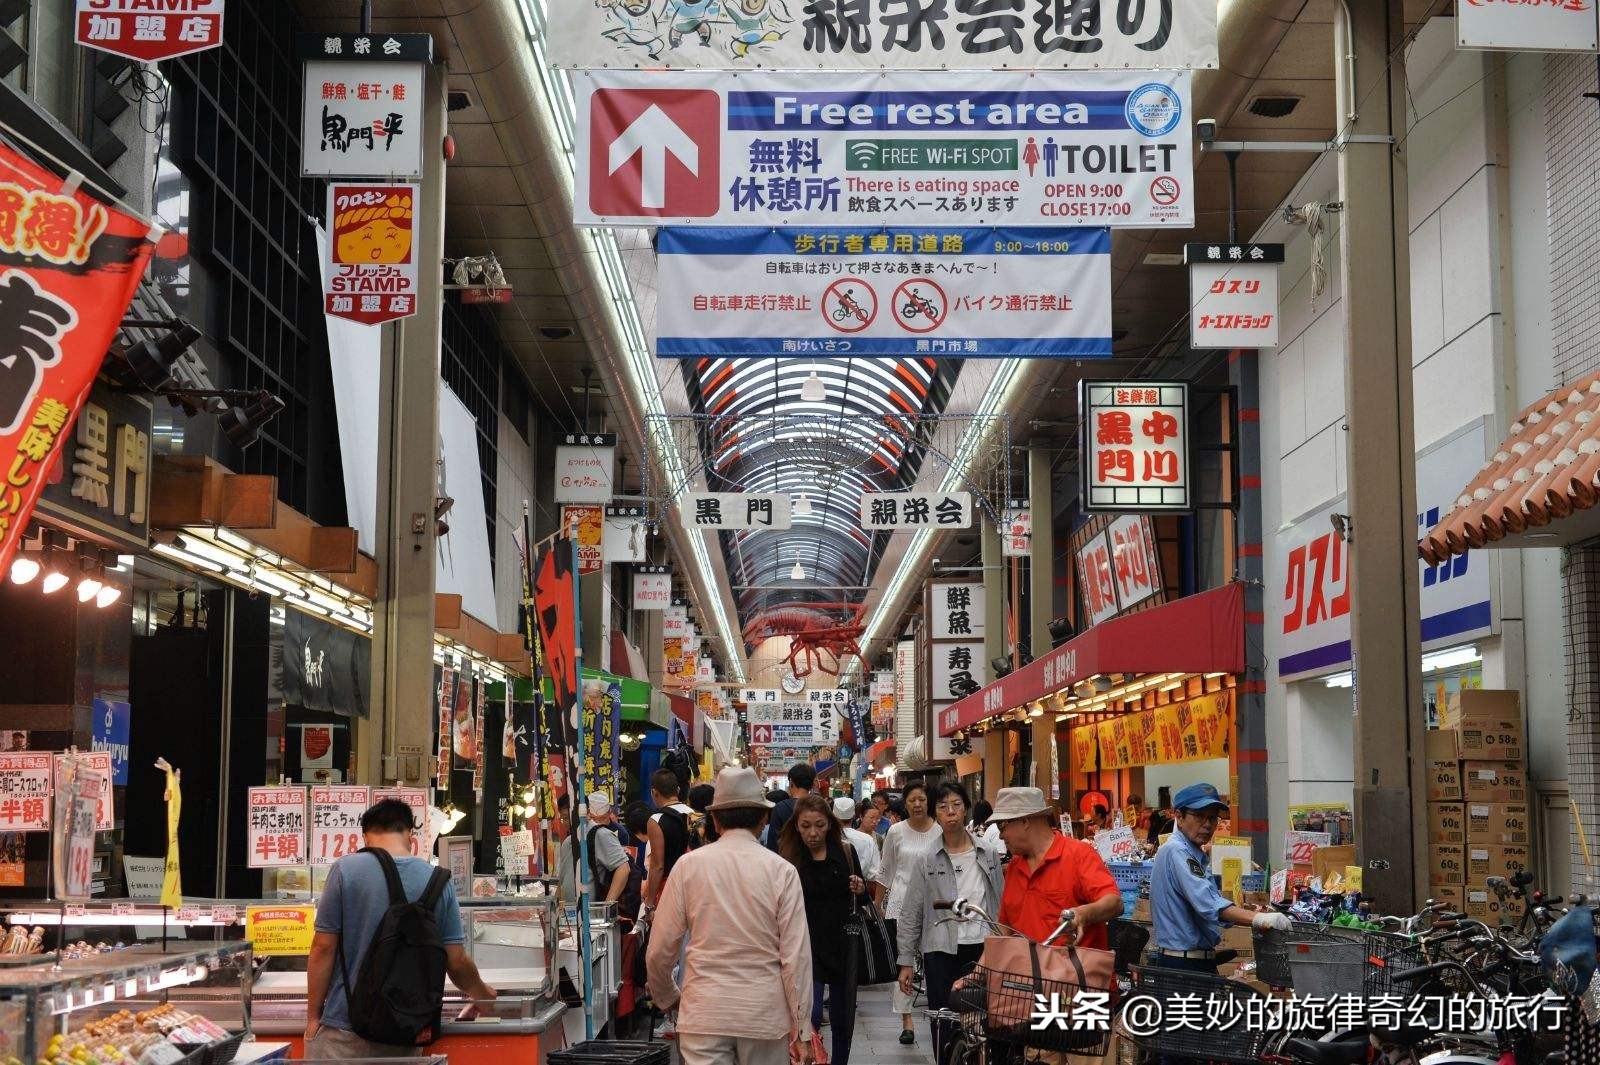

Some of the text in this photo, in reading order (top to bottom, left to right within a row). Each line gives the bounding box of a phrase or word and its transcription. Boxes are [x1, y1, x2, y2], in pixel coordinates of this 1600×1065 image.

[87, 15, 212, 42] 加盟店
[323, 36, 402, 55] 親栄会
[774, 96, 1089, 125] Free rest area
[748, 137, 823, 174] 無料
[882, 147, 1013, 164] FREE Wi-Fi SPOT
[1061, 144, 1177, 173] TOILET
[729, 176, 842, 212] 休憩所
[846, 177, 1020, 197] There is eating space
[1044, 184, 1123, 198] OPEN 9:00
[337, 192, 387, 210] クロモン
[848, 196, 1020, 213] 飲食スペースあります
[795, 234, 965, 253] 歩行者専用道路
[1207, 246, 1265, 260] 親栄会
[338, 264, 402, 278] フレッシュ
[331, 277, 411, 293] STAMP
[1210, 279, 1261, 295] クスリ
[331, 295, 410, 313] 加盟店
[692, 294, 812, 312] 自転車走行禁止
[953, 294, 1074, 312] バイク通行禁止
[782, 340, 852, 352] 南けいさつ
[916, 340, 979, 353] 黒門市場
[71, 402, 149, 524] 黒門
[695, 498, 773, 526] 黒門
[870, 497, 963, 525] 親栄会
[1283, 529, 1351, 635] クスリ
[947, 586, 972, 635] 鮮魚
[1498, 734, 1518, 745] 58g
[1437, 773, 1455, 784] 60g
[0, 798, 45, 824] 半額
[251, 812, 303, 829] 牛肉こま切れ
[1442, 818, 1460, 829] 60g
[1505, 818, 1525, 830] 60g
[256, 834, 299, 860] 半額
[321, 833, 359, 858] 128
[1440, 860, 1460, 871] 60g
[1506, 860, 1524, 871] 60g
